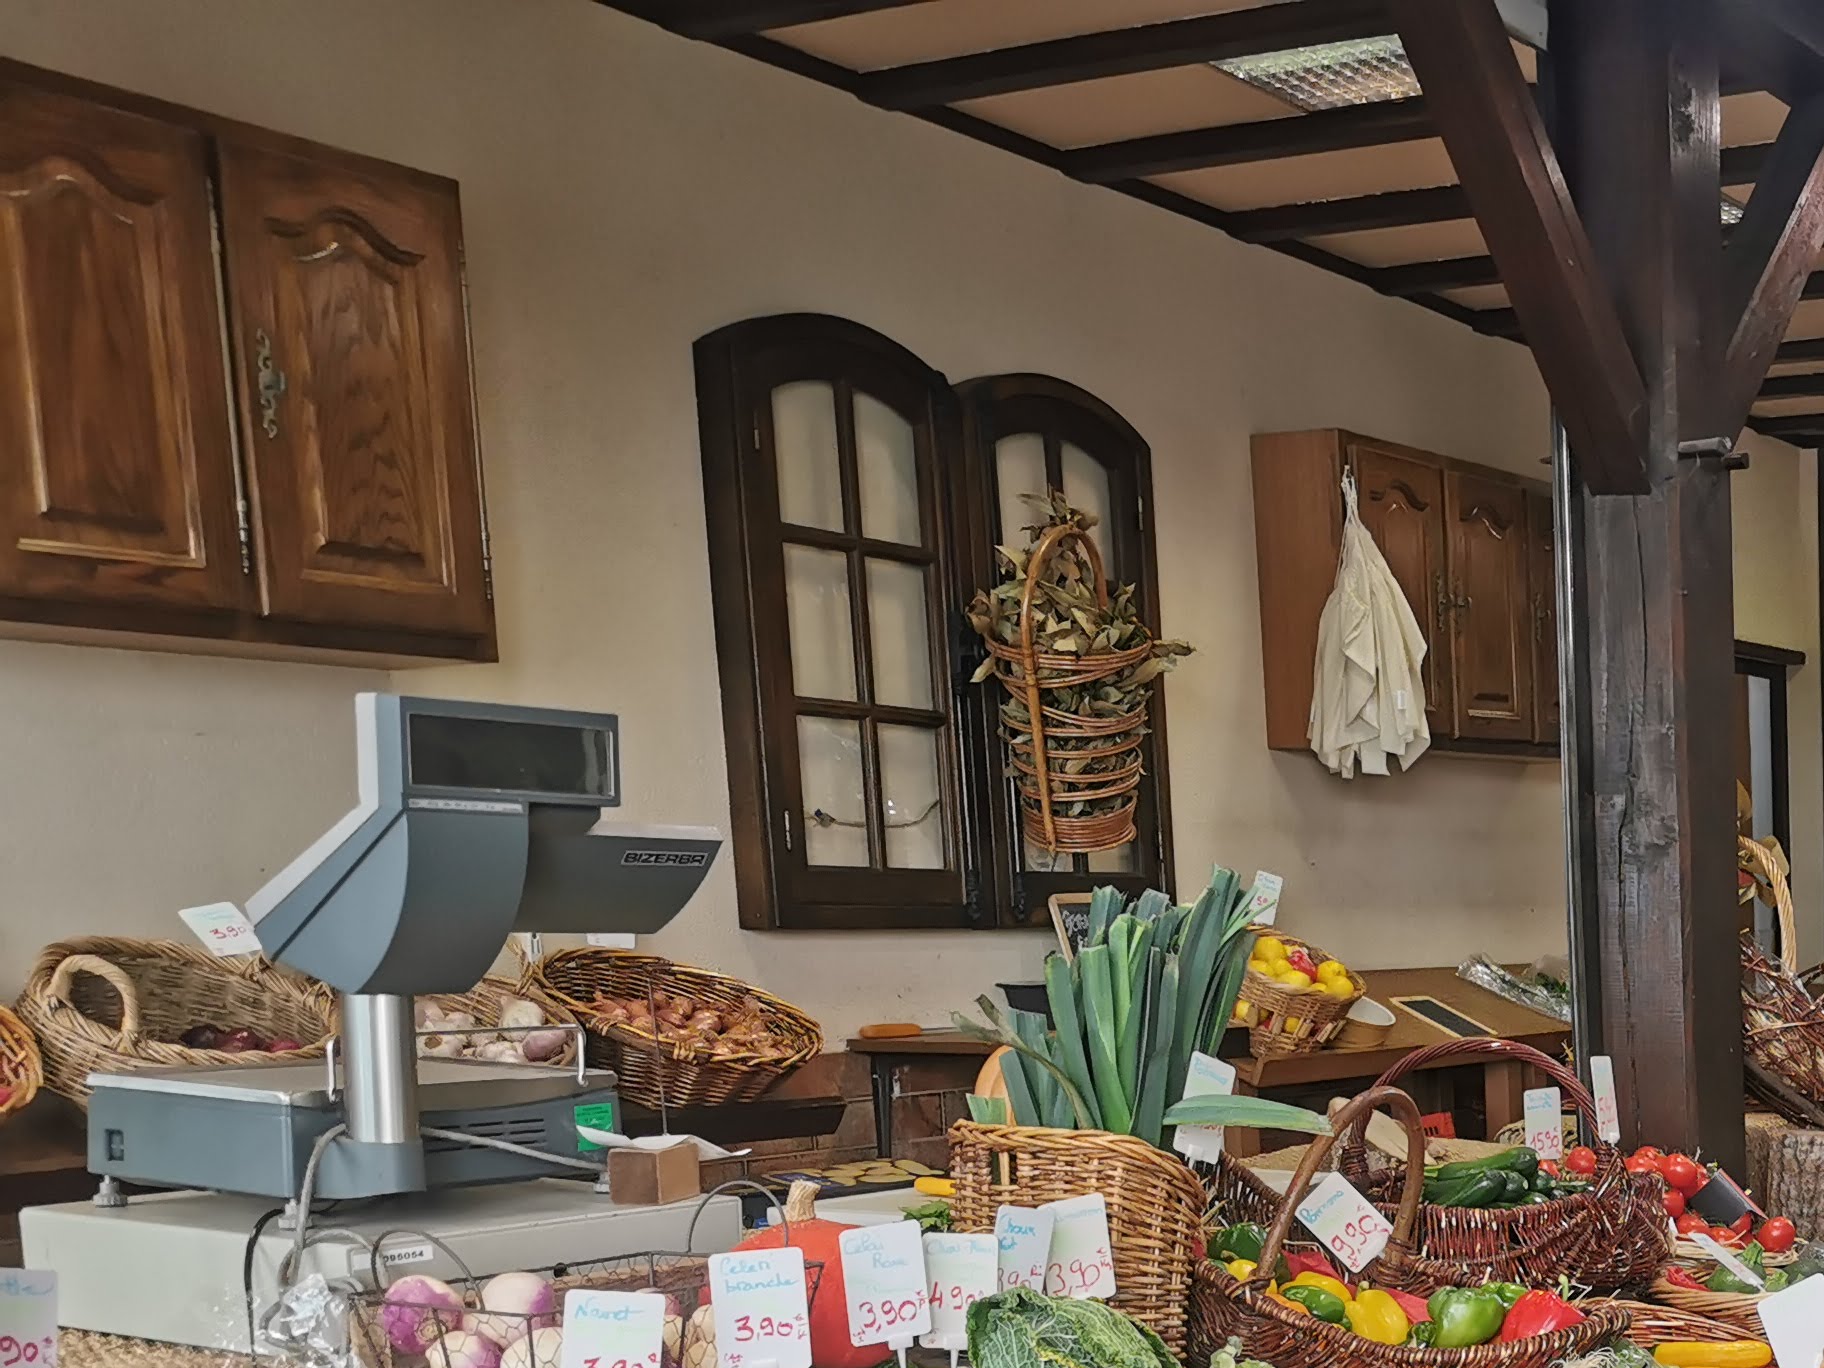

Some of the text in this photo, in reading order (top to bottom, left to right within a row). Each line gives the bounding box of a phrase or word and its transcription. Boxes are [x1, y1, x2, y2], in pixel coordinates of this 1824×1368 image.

[623, 852, 705, 866] BIZERBA
[734, 1315, 794, 1342] 3,90
[858, 1299, 918, 1333] 3,90
